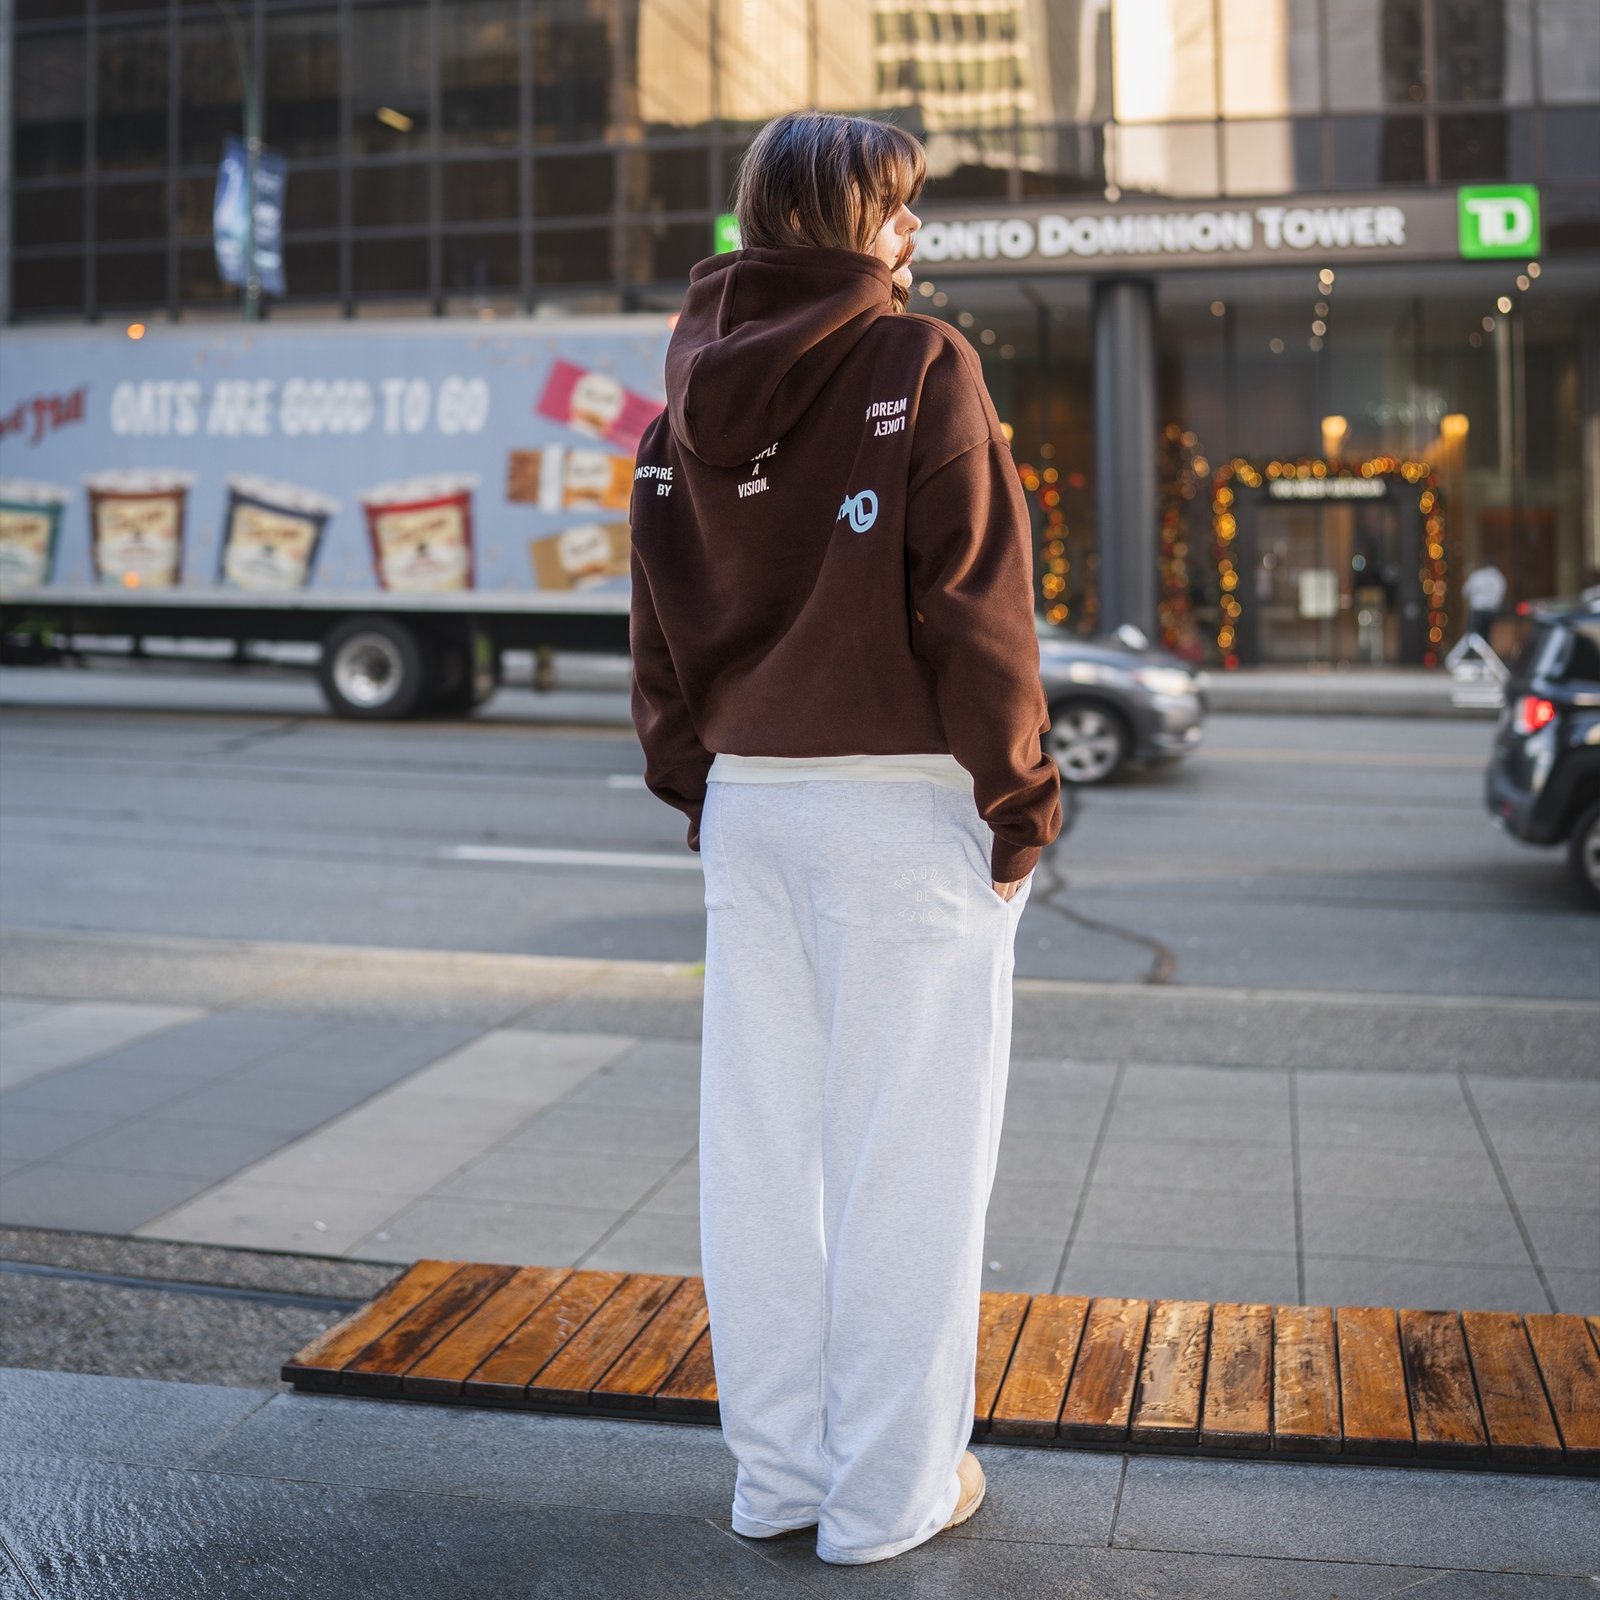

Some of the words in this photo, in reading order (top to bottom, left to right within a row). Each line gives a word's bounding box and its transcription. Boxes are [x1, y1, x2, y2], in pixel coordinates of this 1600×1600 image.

[1037, 207, 1254, 258] DOMINION
[1255, 206, 1406, 250] TOWER
[1465, 197, 1533, 248] TD
[111, 380, 198, 436] OATS
[206, 379, 275, 437] ARE
[281, 377, 374, 436] GOOD
[381, 378, 432, 435] TO
[437, 376, 491, 436] GO
[872, 398, 907, 417] DREAM
[874, 416, 906, 437] LOKEY
[752, 463, 760, 476] A
[656, 484, 673, 497] BY
[738, 477, 770, 498] VISION.
[895, 866, 950, 890] ESTUDIO
[916, 890, 929, 902] DE
